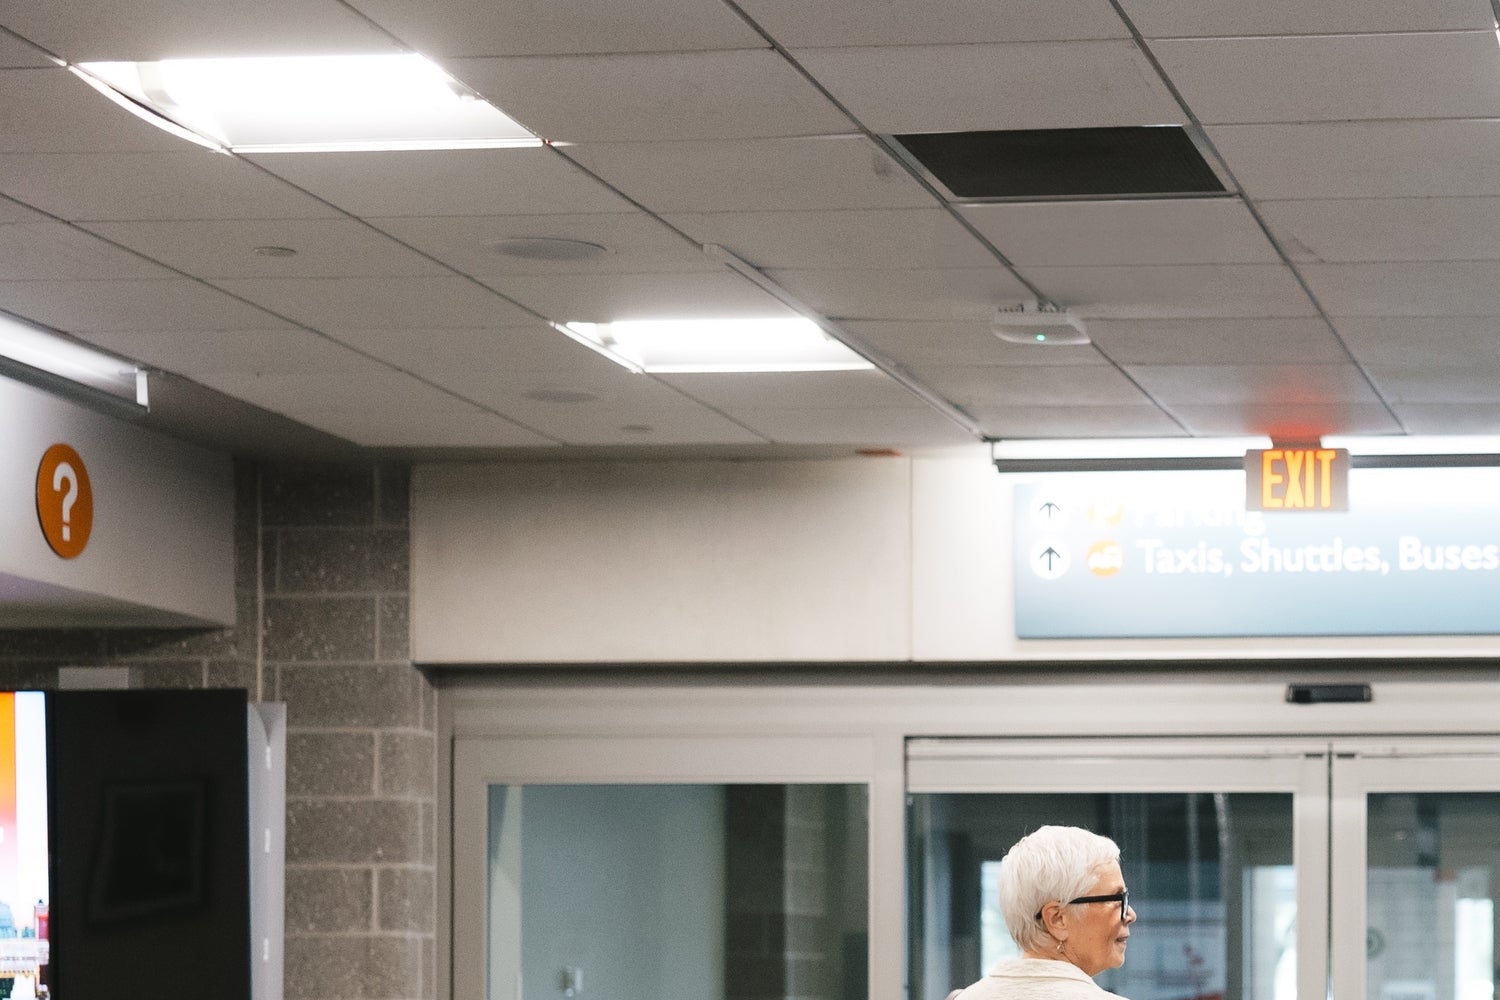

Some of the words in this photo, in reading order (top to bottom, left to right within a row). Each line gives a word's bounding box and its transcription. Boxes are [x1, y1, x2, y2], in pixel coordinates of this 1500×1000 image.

[1261, 450, 1336, 509] EXIT
[1137, 538, 1232, 577] Taxis,
[1240, 537, 1389, 576] Shuttles,
[1400, 536, 1499, 572] Buses
